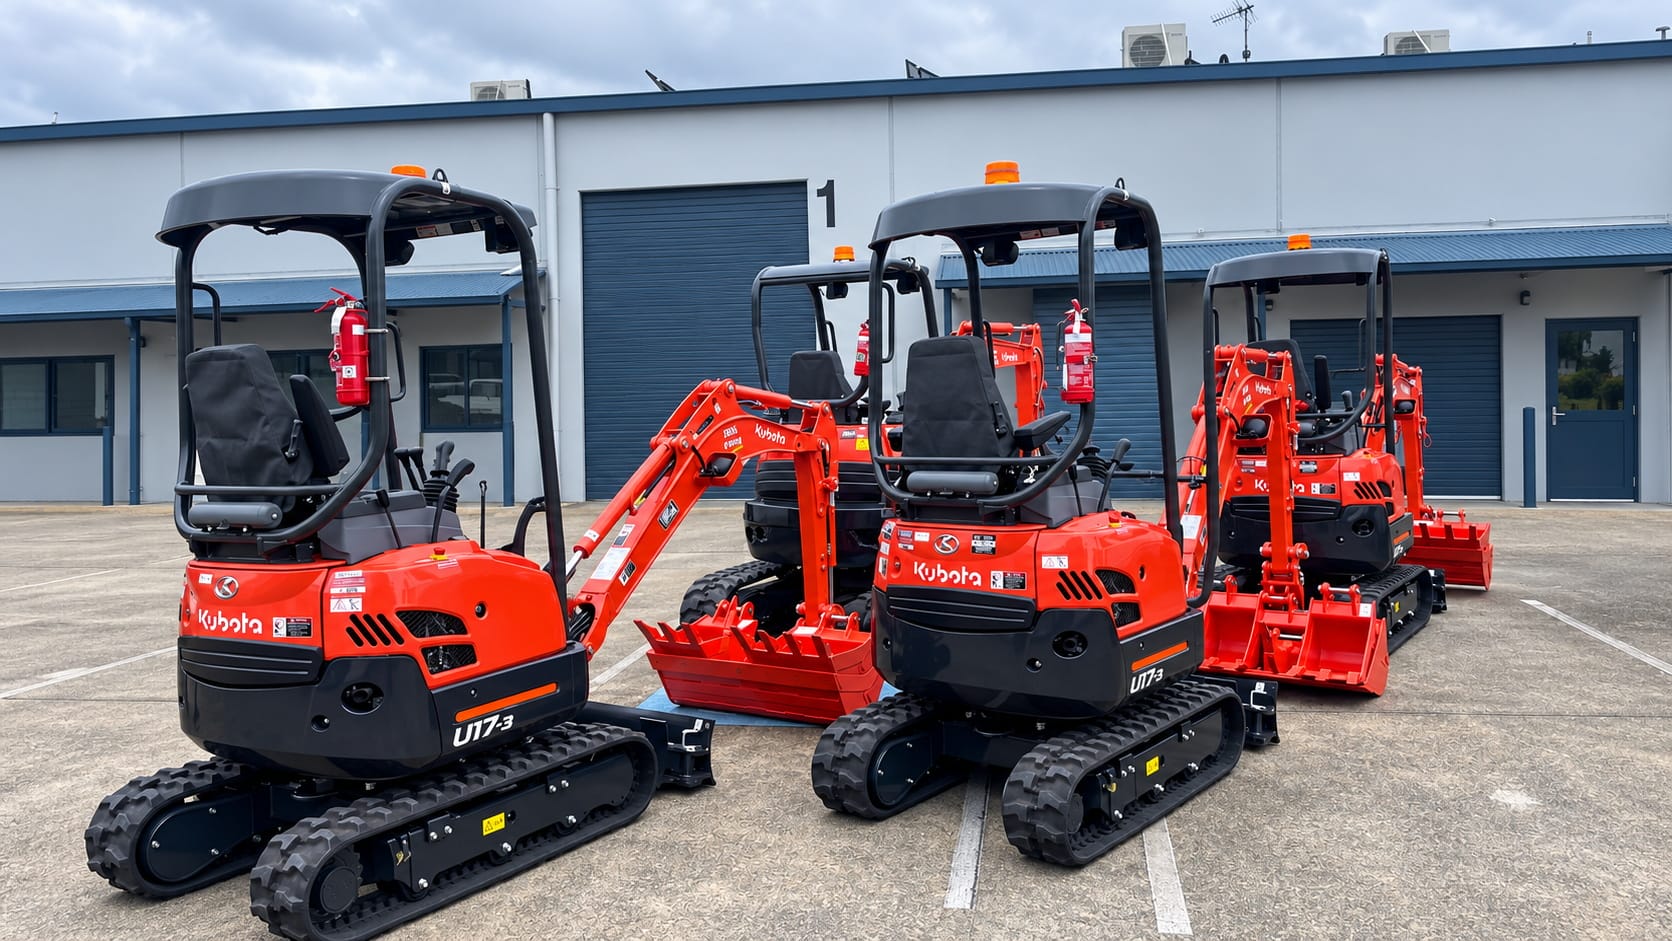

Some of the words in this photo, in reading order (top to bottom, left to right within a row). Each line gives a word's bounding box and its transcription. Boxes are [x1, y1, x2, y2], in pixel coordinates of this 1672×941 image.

[816, 179, 836, 228] 1
[755, 423, 787, 445] Kubota
[913, 561, 982, 587] Kubota
[198, 608, 263, 635] Kubota
[1130, 667, 1164, 694] U17-3
[452, 713, 515, 748] U17-3
